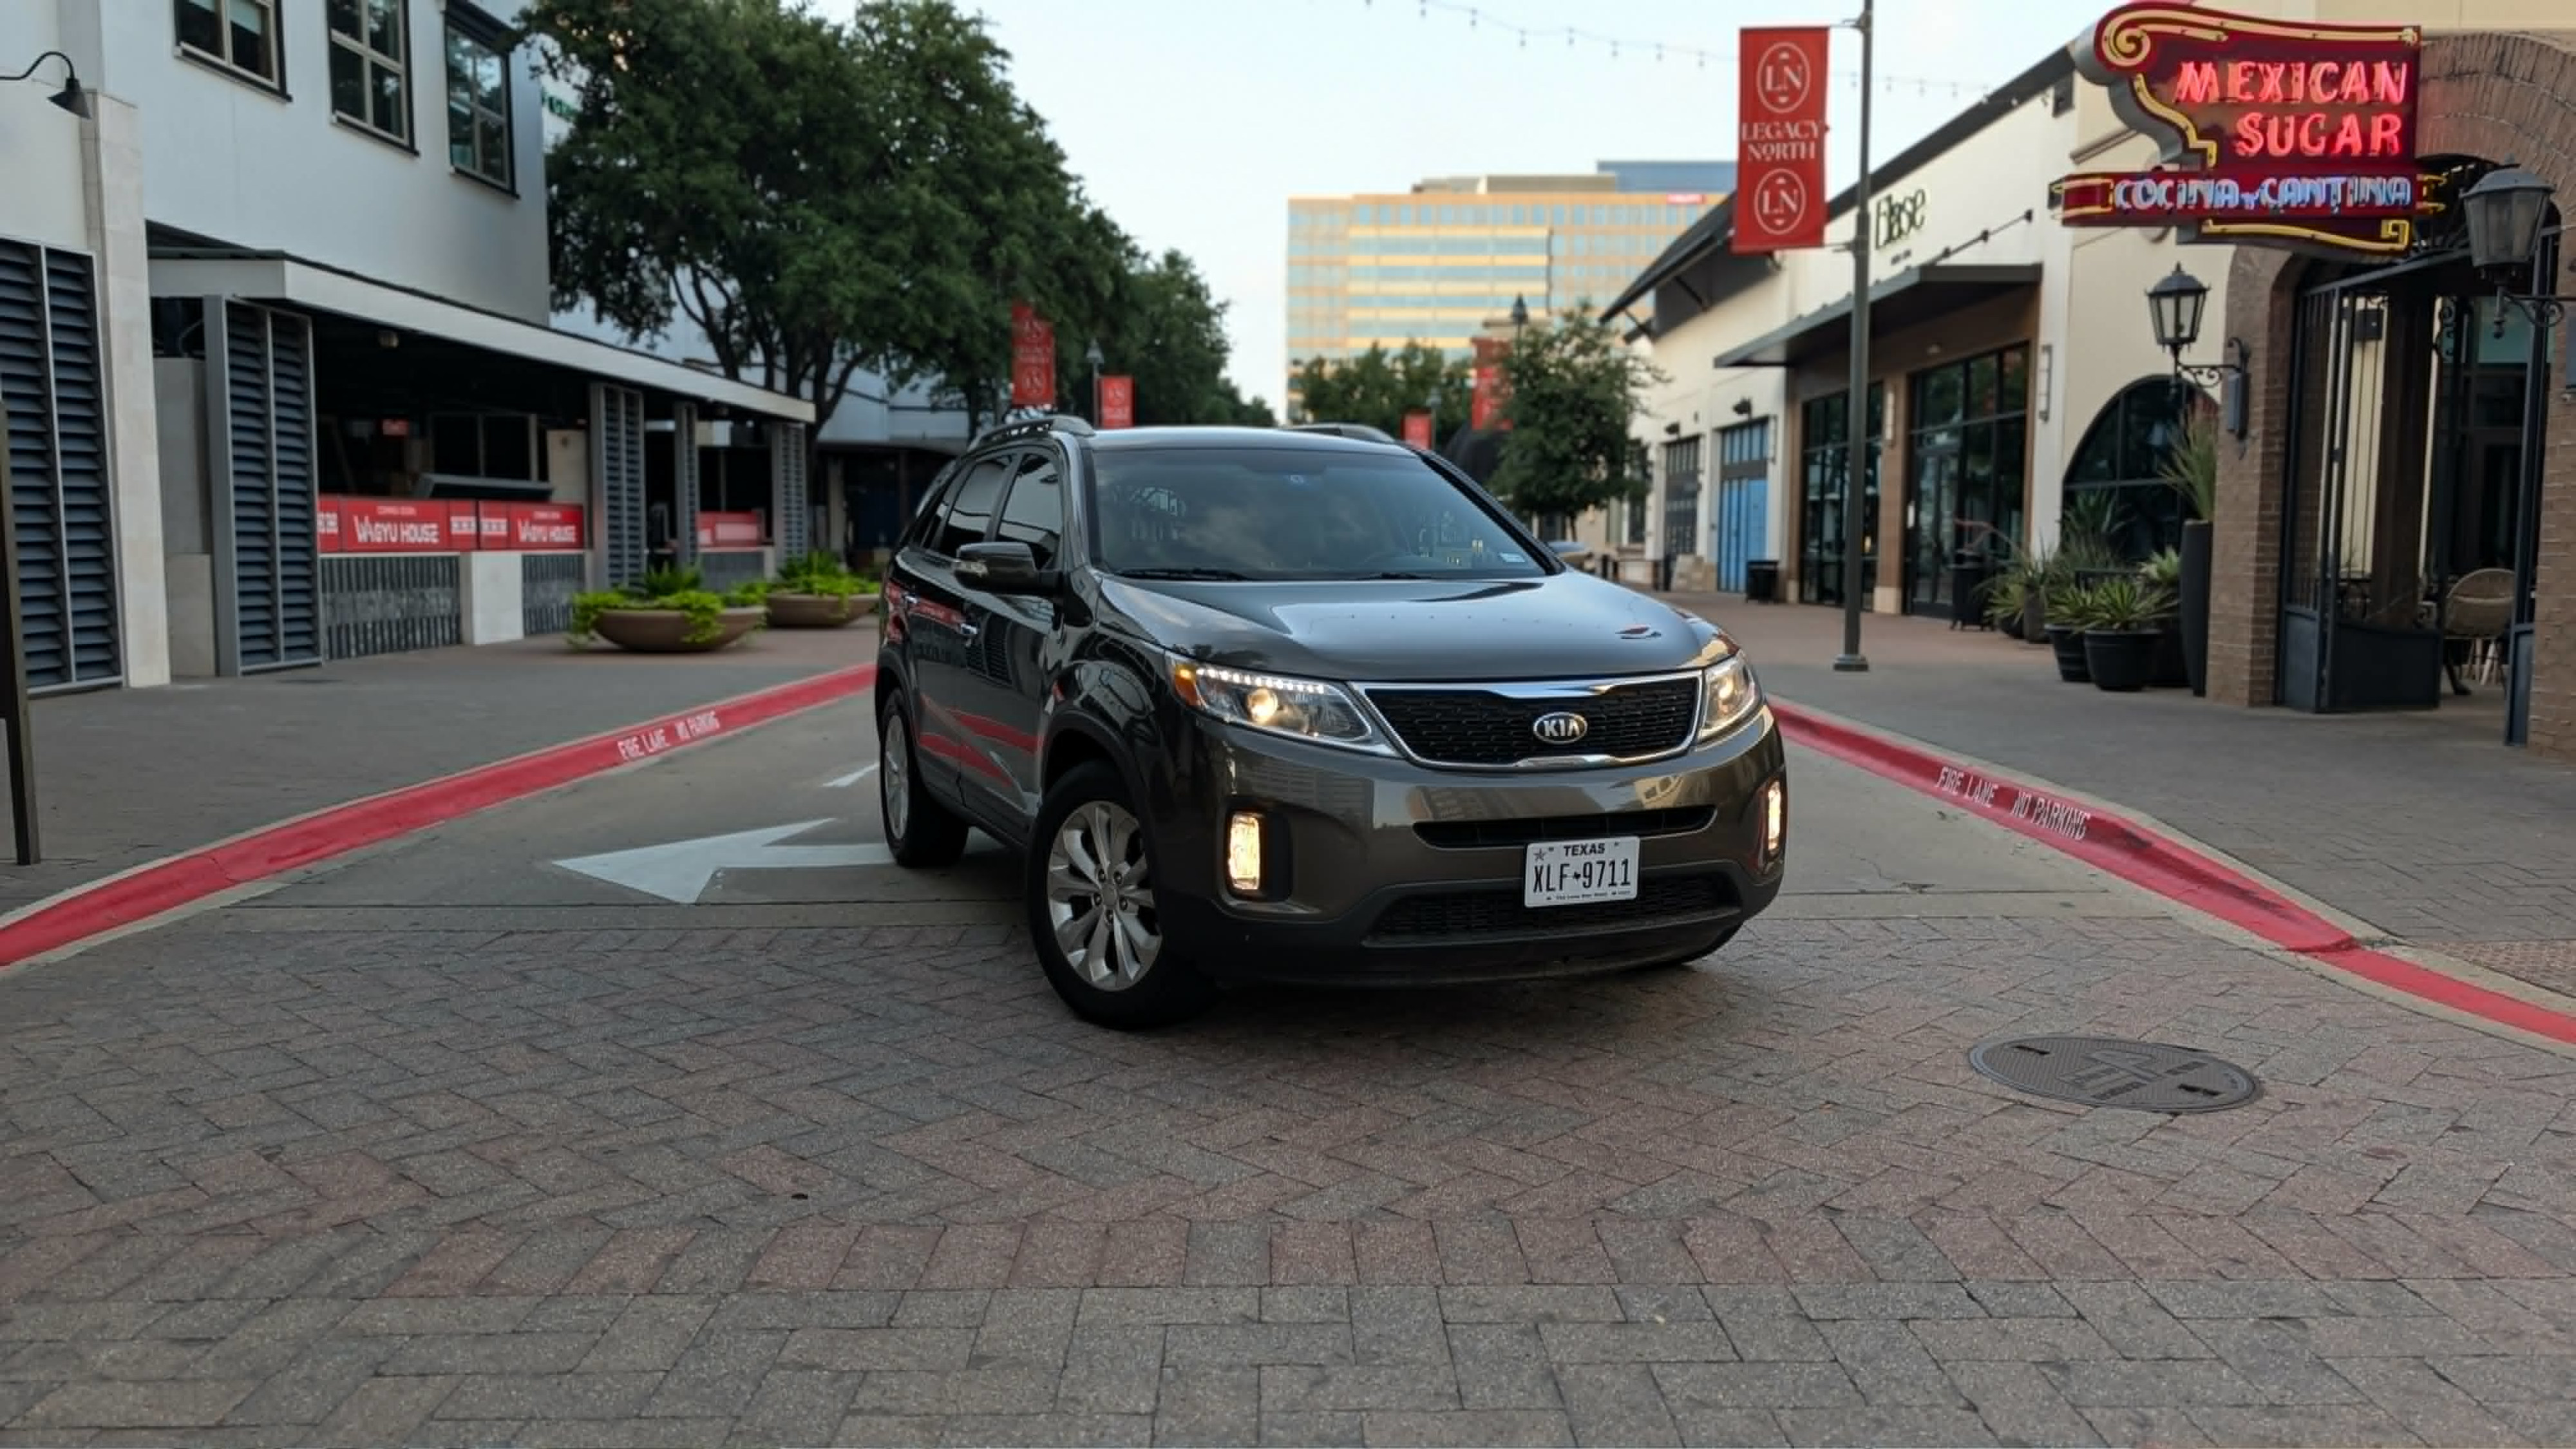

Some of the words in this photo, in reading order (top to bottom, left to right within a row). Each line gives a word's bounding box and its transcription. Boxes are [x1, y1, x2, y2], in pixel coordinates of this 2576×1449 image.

[1765, 65, 1803, 91] LN
[2175, 61, 2407, 103] MEXICAN
[1741, 120, 1819, 141] LEGACY
[2233, 112, 2403, 156] SUGAR
[1748, 141, 1816, 161] NORTH
[1763, 188, 1799, 214] LN
[2114, 178, 2240, 210] COCINA
[2259, 176, 2412, 207] CANTINA
[399, 522, 440, 544] HOUSE
[1544, 719, 1580, 737] KIA
[1935, 766, 1964, 796] FIRE
[1964, 775, 1999, 808] LANE
[2011, 788, 2032, 819] NO
[2031, 797, 2091, 840] PARKING
[1564, 843, 1605, 857] TEXAS
